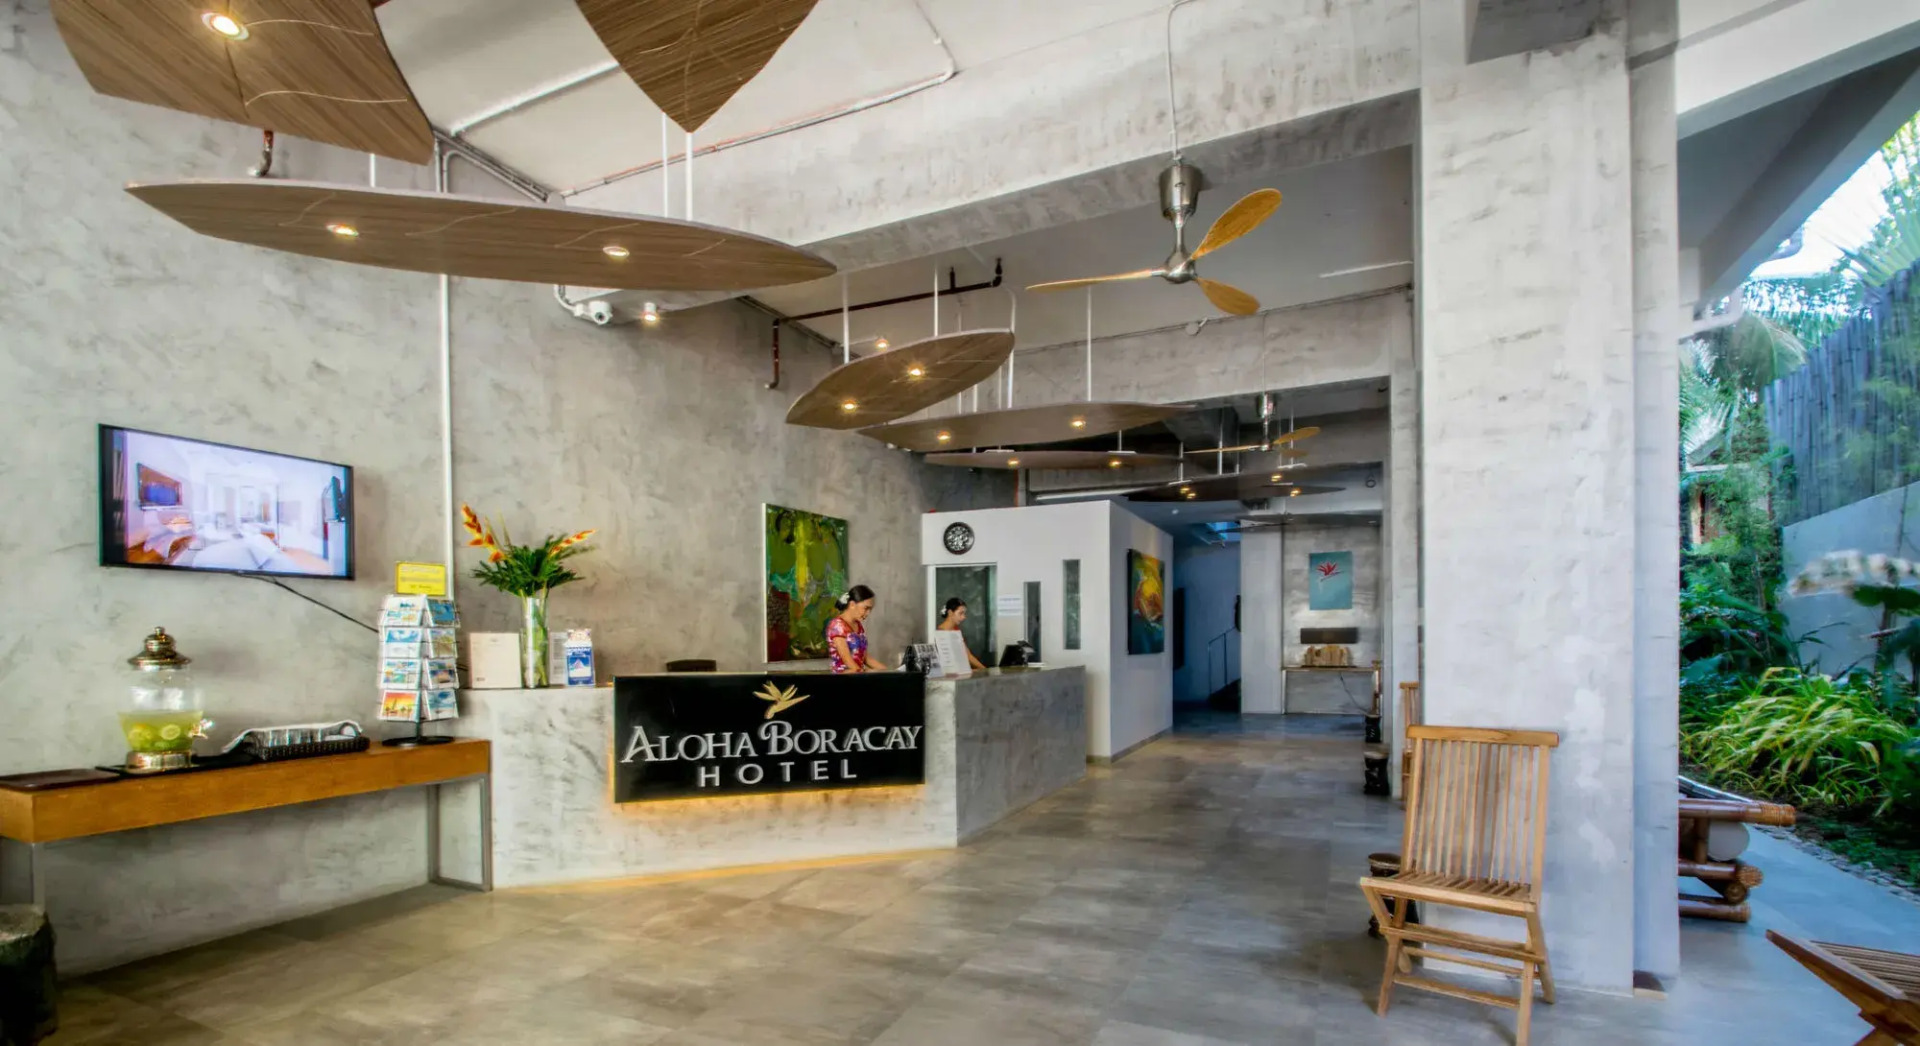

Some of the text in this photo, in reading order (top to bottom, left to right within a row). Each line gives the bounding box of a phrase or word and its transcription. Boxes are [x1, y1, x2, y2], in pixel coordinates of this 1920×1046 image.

[620, 720, 923, 763] ALOHA BORACAY
[699, 758, 857, 787] HOTEL
